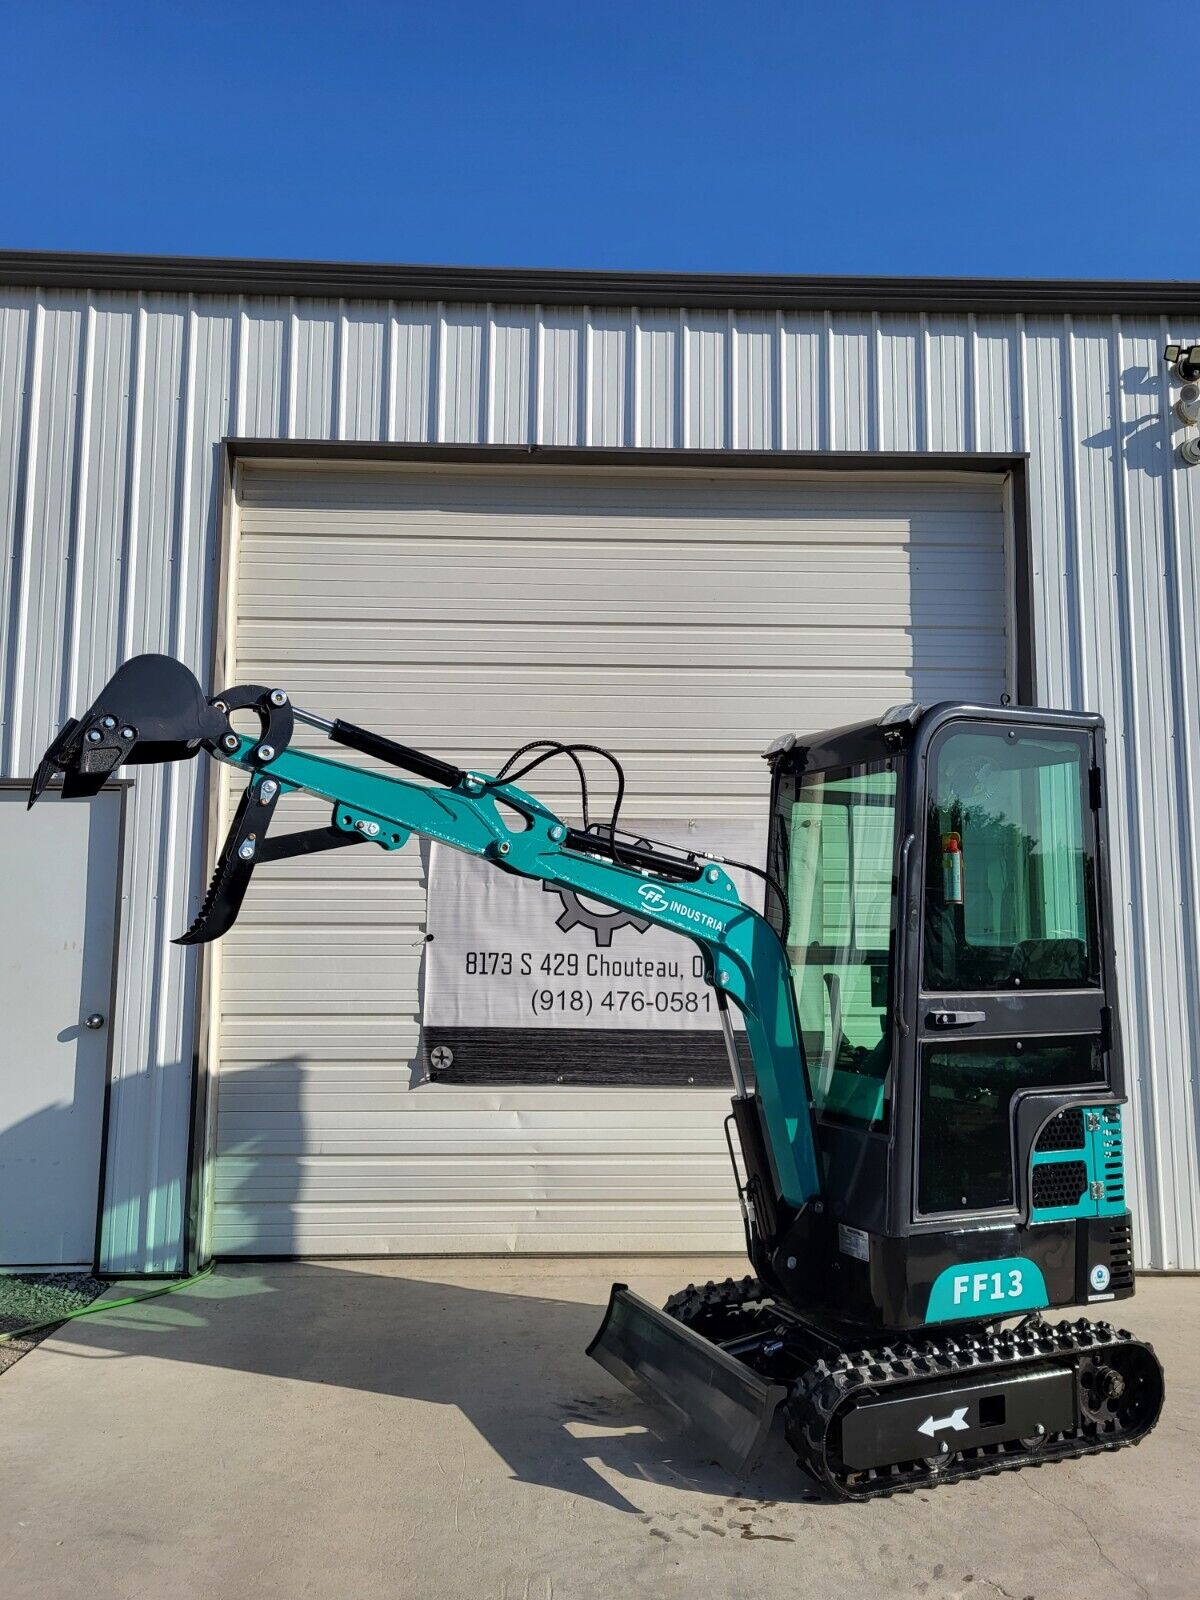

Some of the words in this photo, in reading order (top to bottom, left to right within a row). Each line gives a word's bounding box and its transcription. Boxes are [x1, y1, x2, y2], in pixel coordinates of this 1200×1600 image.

[669, 900, 727, 934] INDUSTRIAL
[466, 952, 512, 975] 8173
[520, 953, 532, 976] S
[540, 953, 579, 976] 429
[586, 953, 684, 981] Chouteau,
[692, 955, 703, 978] O
[531, 989, 593, 1016] (918)
[600, 990, 710, 1013] 476-0581
[953, 1269, 1023, 1305] FF13
